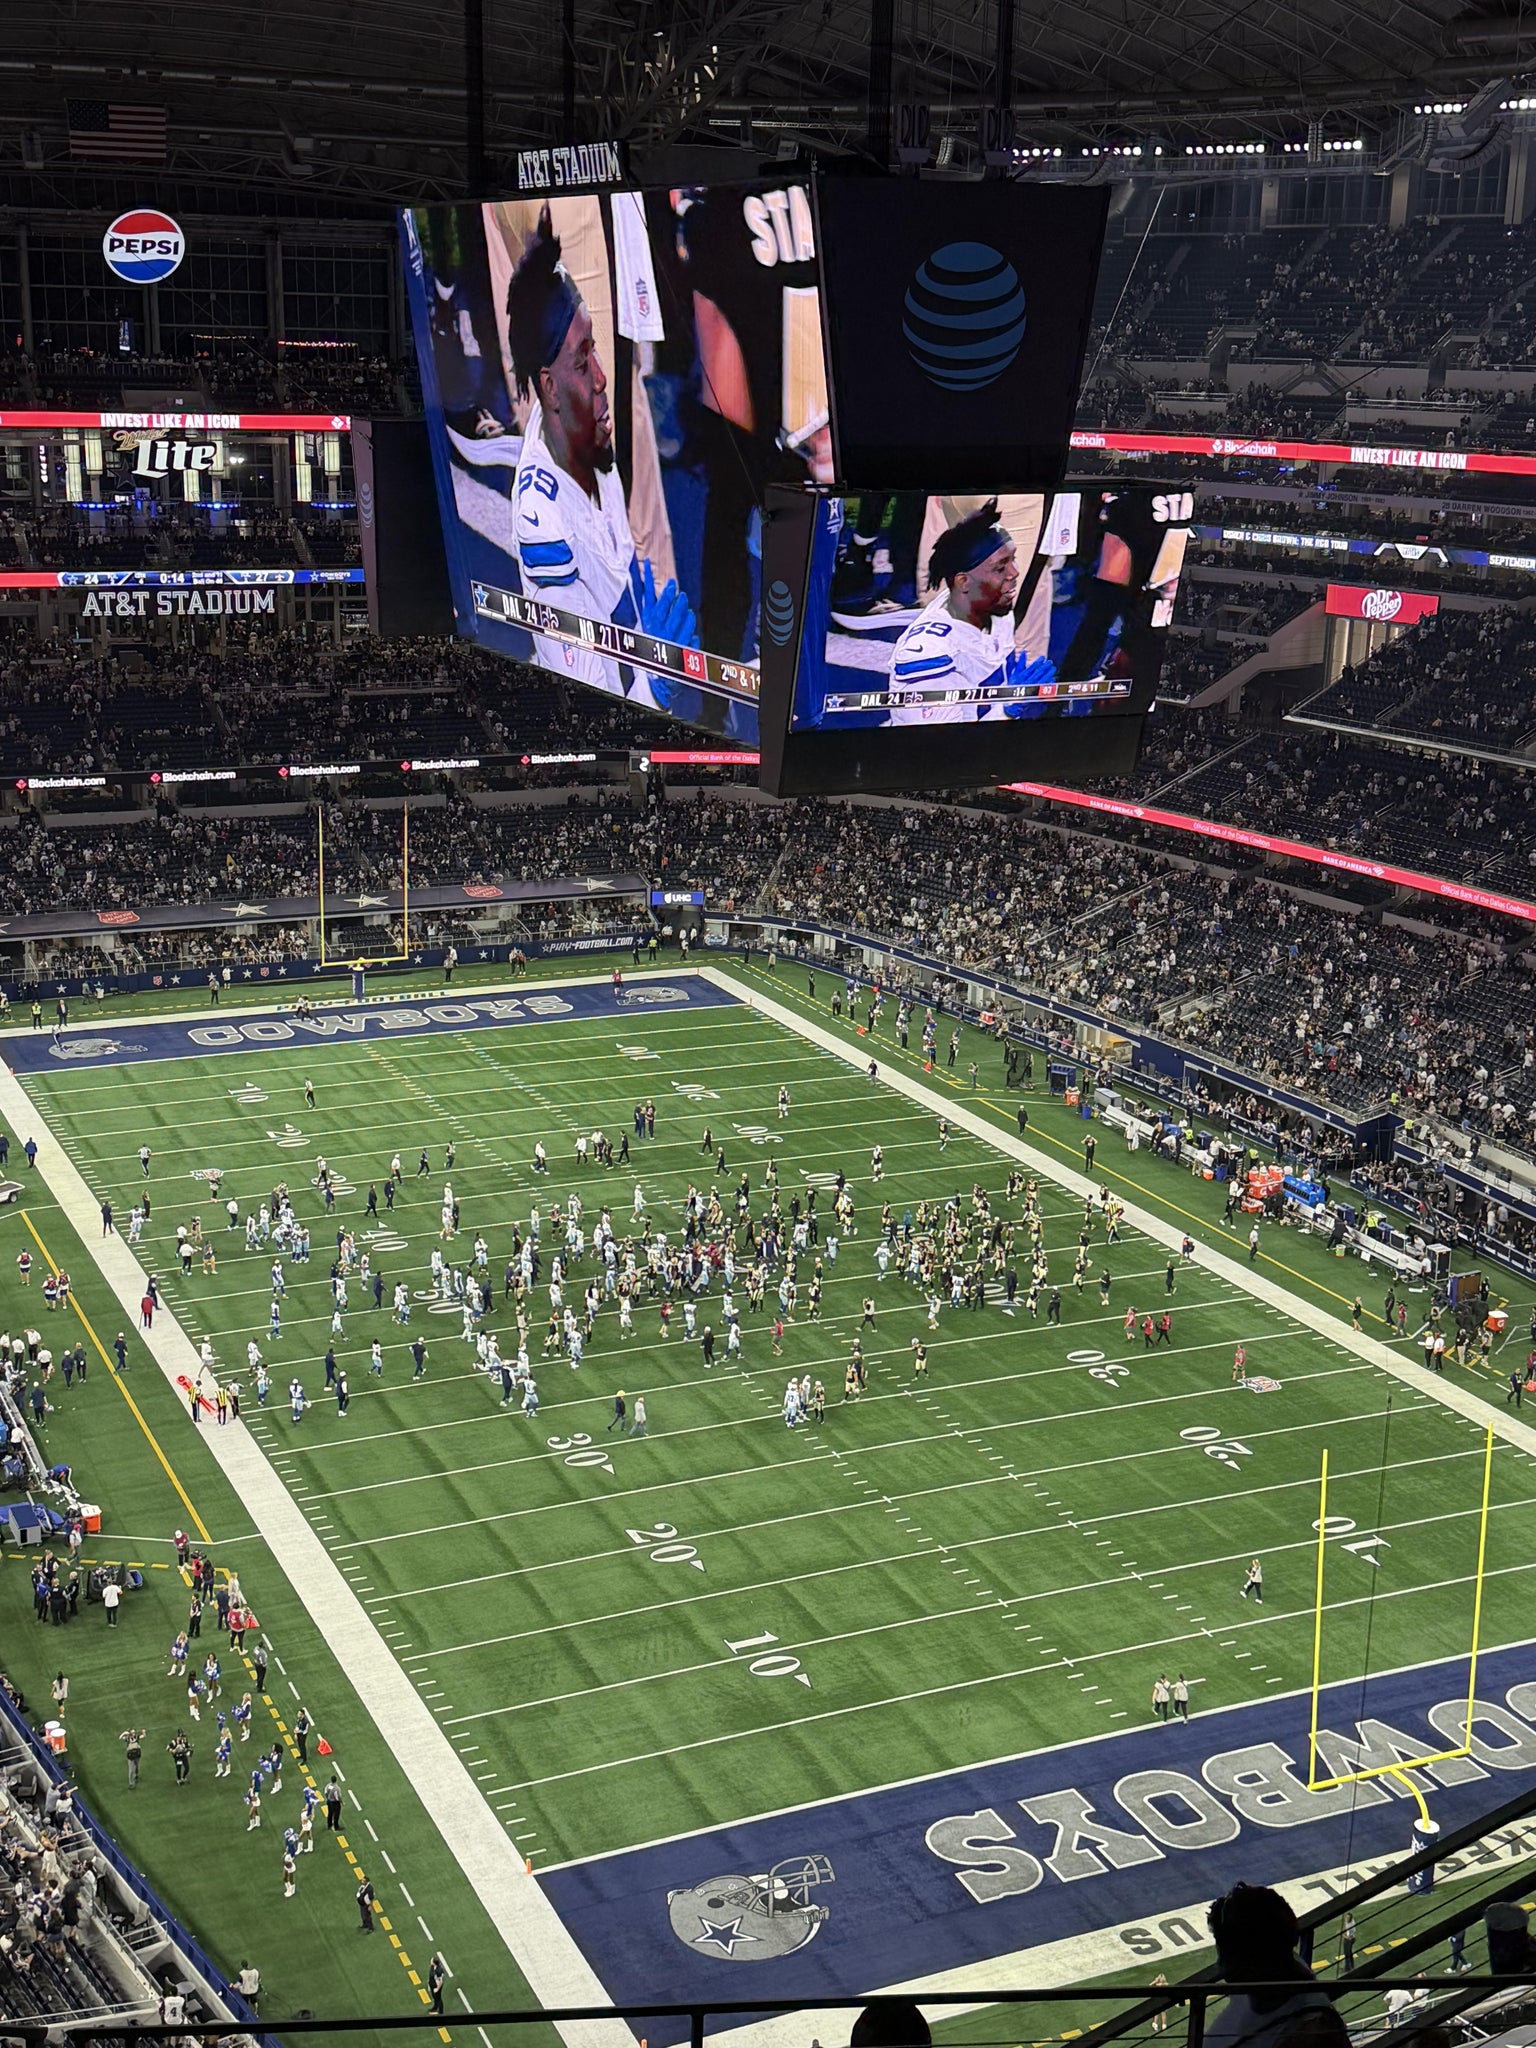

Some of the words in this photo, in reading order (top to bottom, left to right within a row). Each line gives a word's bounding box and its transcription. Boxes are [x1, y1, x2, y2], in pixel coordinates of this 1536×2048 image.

[518, 149, 551, 189] AT&T
[552, 141, 622, 186] STADIUM
[109, 237, 179, 256] PEPSI
[101, 413, 150, 428] INVEST
[153, 414, 182, 428] LIKE
[185, 415, 204, 429] AN
[207, 415, 240, 429] ICON
[132, 439, 217, 479] Lite
[1351, 448, 1389, 465] INVEST
[1392, 451, 1417, 467] LIKE
[1420, 452, 1437, 467] AN
[1439, 454, 1467, 470] ICON
[1489, 552, 1535, 571] SEPTEMBER
[84, 573, 99, 585] 24
[160, 573, 185, 584] 0:14
[255, 573, 268, 583] 27
[82, 592, 149, 616] AT&T
[157, 590, 275, 616] STADIUM
[1366, 593, 1402, 618] Pepper
[501, 593, 521, 617] DAL
[525, 602, 538, 624] 24
[579, 618, 595, 643] NO
[600, 626, 612, 648] 27
[653, 642, 668, 664] :14
[740, 672, 748, 688] &
[860, 694, 882, 707] DAL
[887, 693, 900, 706] 24
[965, 690, 977, 702] 27
[1012, 686, 1025, 697] :14
[411, 757, 480, 771] Blockchain.com
[531, 751, 596, 765] Blockchain.com
[162, 770, 236, 783] Blockchain.com
[290, 764, 360, 777] Blockchain.com
[28, 776, 106, 790] Blockchain.com
[1347, 862, 1372, 874] AMERICA
[672, 894, 692, 902] UHC
[1460, 890, 1472, 900] Bank
[1480, 895, 1489, 905] the
[1506, 902, 1530, 916] Cowboys
[188, 995, 575, 1047] COWBOYS
[360, 1229, 409, 1252] 40
[1066, 1350, 1130, 1381] 30
[547, 1433, 609, 1467] 30
[1179, 1426, 1253, 1461] 20
[625, 1523, 698, 1563] 20
[1312, 1516, 1391, 1553] 10
[724, 1630, 801, 1677] 10
[1120, 1917, 1205, 1955] US
